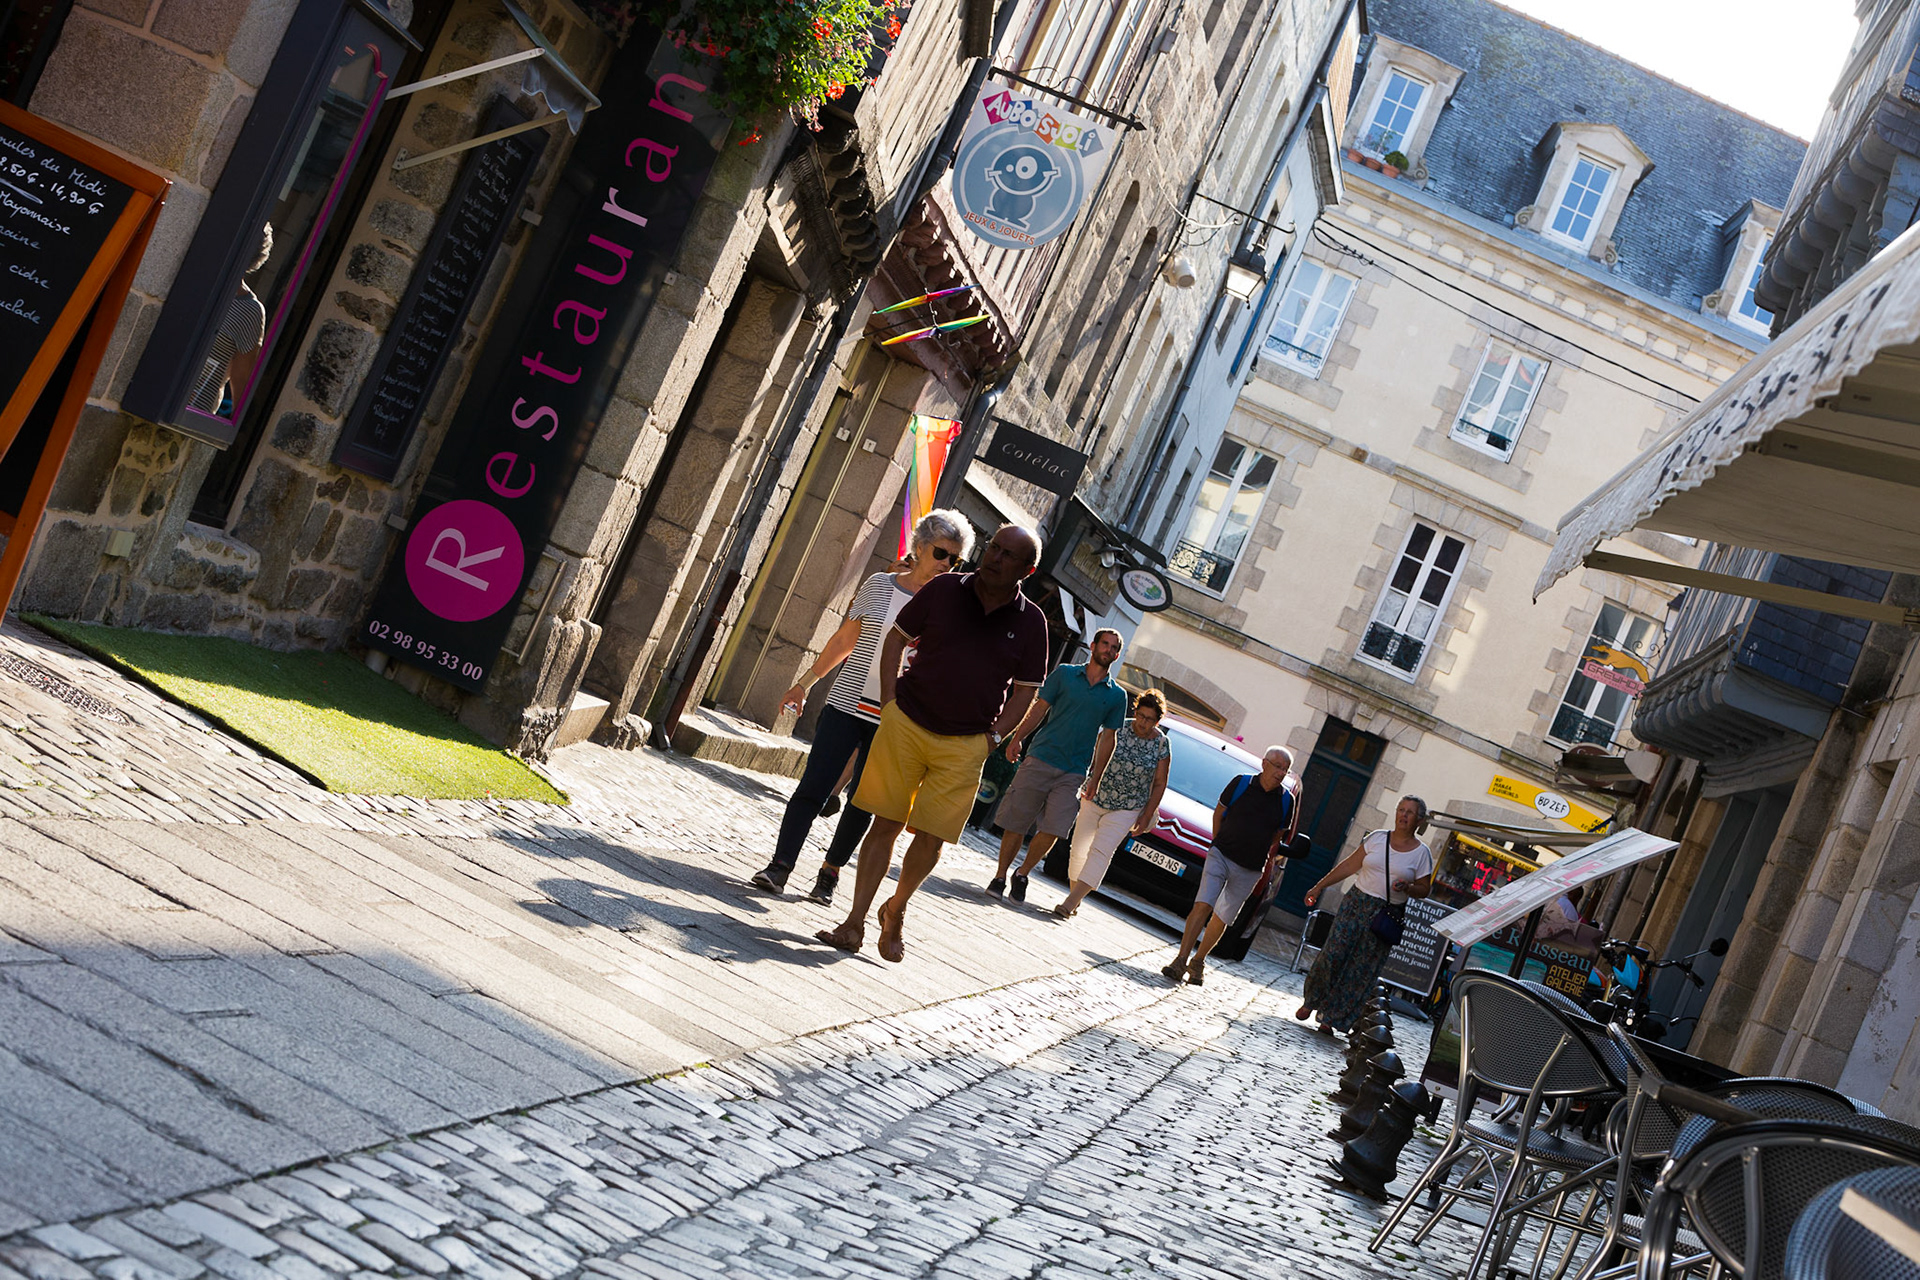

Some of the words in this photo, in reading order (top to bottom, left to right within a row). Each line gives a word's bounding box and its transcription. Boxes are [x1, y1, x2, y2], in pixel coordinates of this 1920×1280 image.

[40, 158, 60, 173] du
[68, 167, 107, 196] Midi
[964, 211, 989, 227] JEUX
[990, 221, 996, 230] &
[999, 225, 1035, 246] JOUETS
[425, 30, 716, 592] Restauran
[369, 620, 390, 639] 02
[392, 630, 413, 649] 98
[415, 641, 436, 659] 95
[438, 651, 459, 670] 33
[462, 662, 483, 680] 00
[1405, 906, 1420, 918] Red
[1407, 896, 1446, 917] Belstaff
[1402, 929, 1437, 946] arbour
[1545, 976, 1585, 998] GALERIE
[1549, 965, 1588, 987] ATELIER
